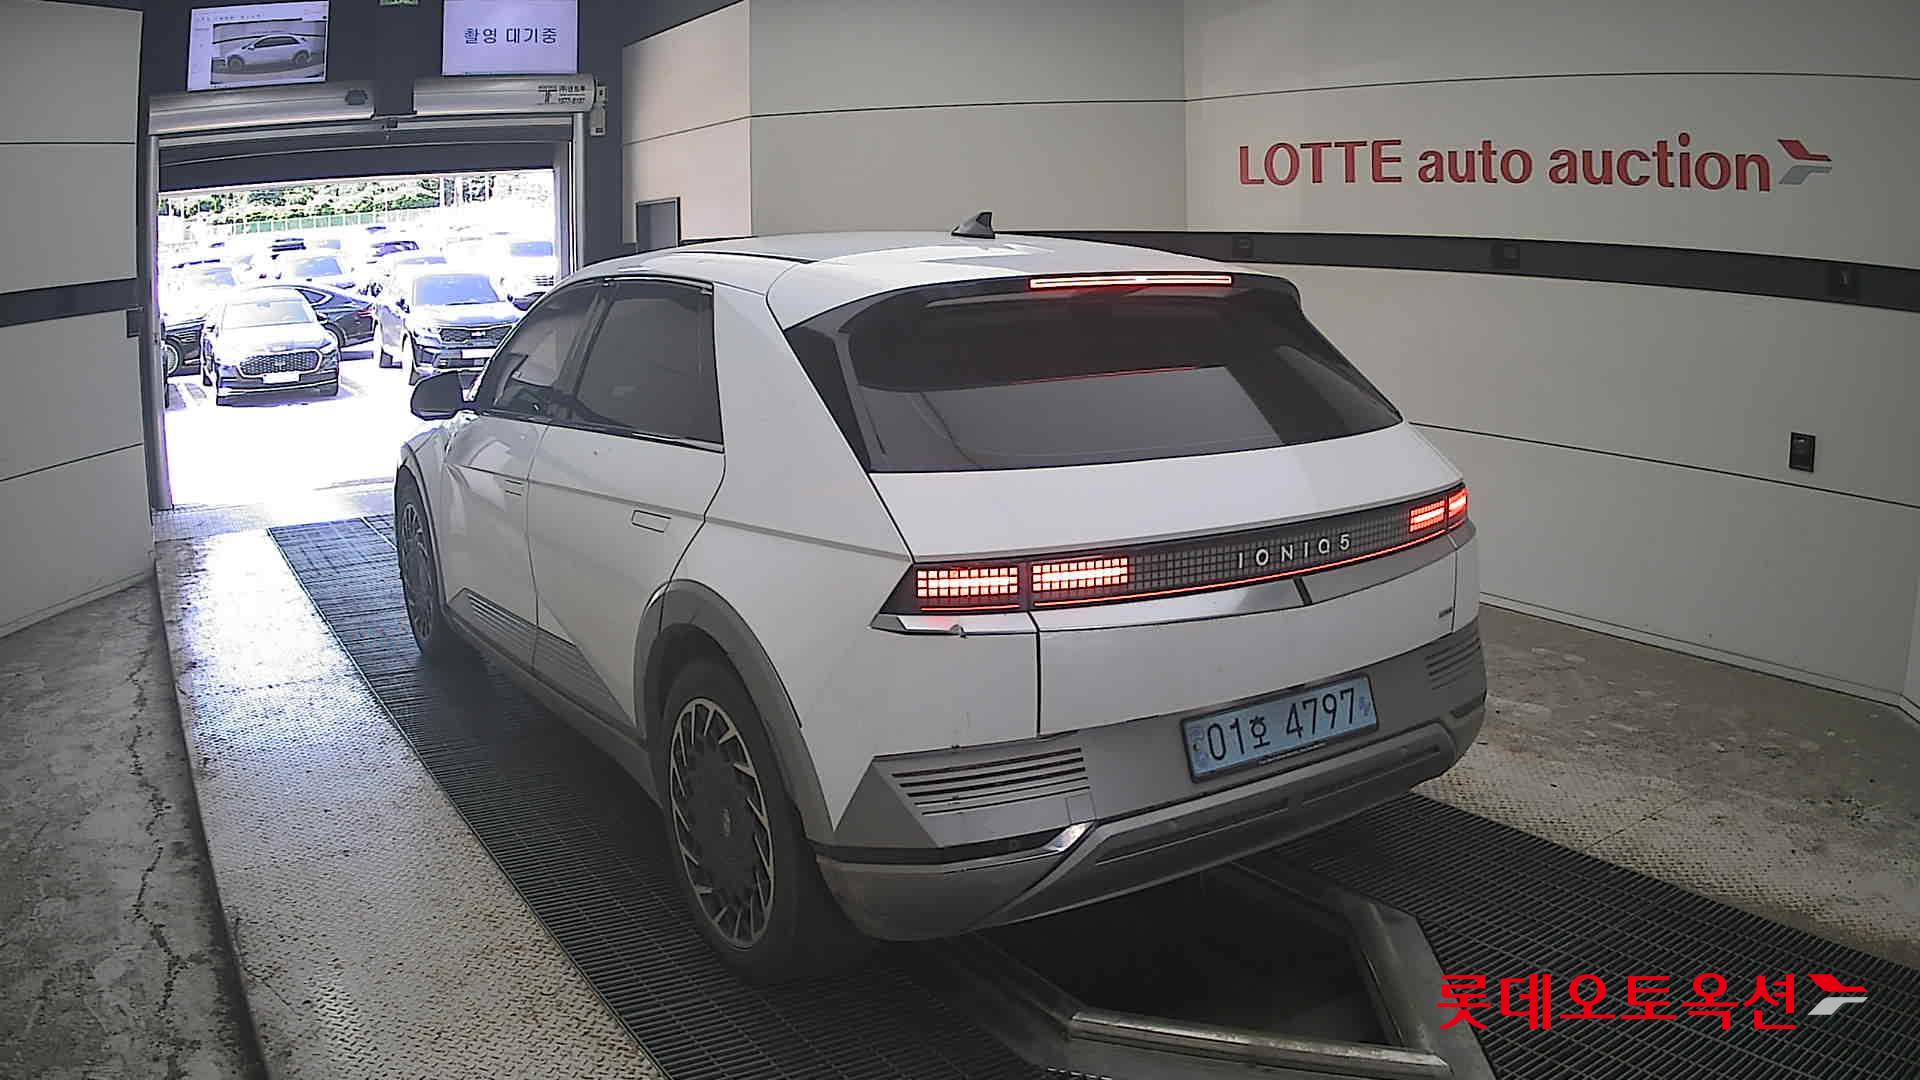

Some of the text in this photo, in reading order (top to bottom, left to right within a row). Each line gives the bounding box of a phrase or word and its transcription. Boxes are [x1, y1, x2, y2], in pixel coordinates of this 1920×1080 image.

[464, 27, 558, 45] 촬영 대기중
[1238, 133, 1771, 192] LOTTE auto auction
[1207, 715, 1271, 761] 01호
[1285, 688, 1356, 739] 4797
